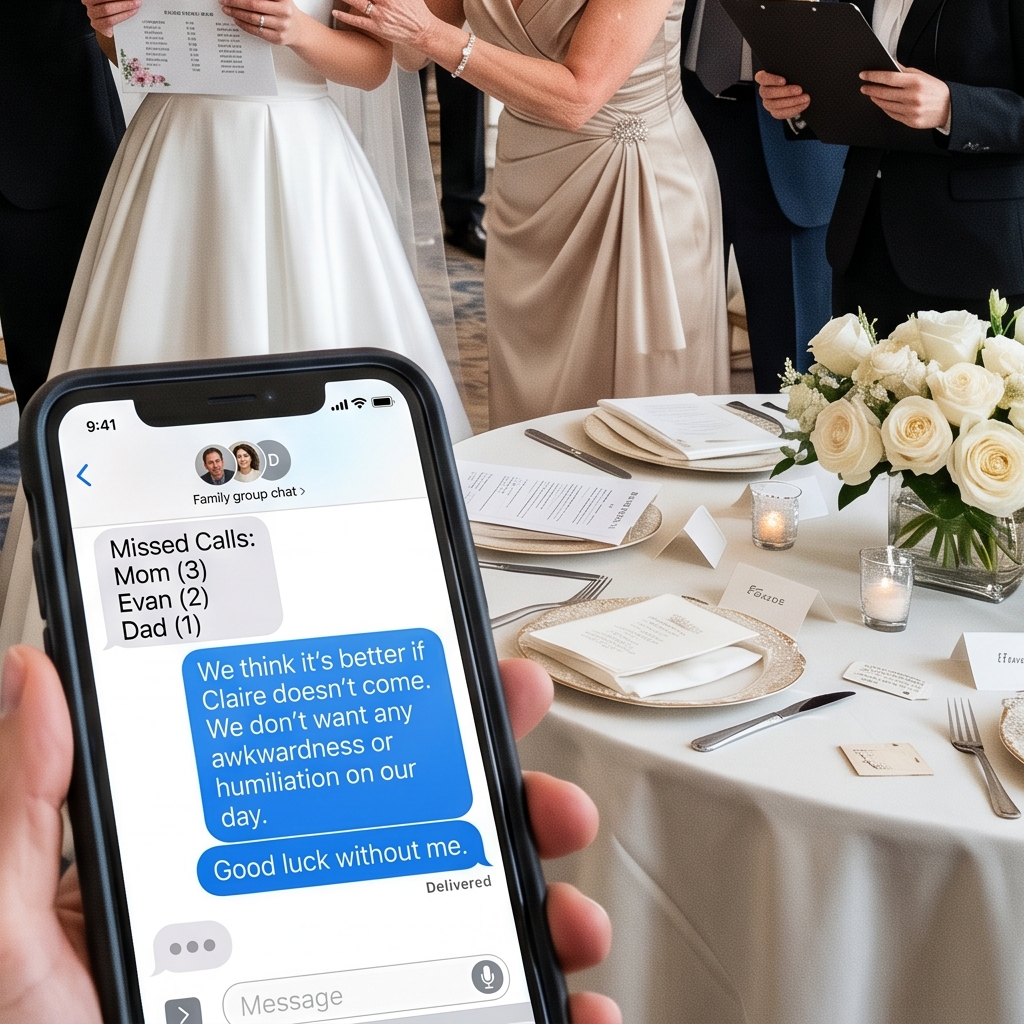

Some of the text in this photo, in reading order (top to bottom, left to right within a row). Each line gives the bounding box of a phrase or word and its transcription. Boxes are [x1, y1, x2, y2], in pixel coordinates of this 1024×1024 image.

[86, 418, 116, 433] 9:41
[267, 453, 280, 467] D
[193, 486, 298, 505] Family group chat
[109, 528, 255, 559] Missed Calls:
[113, 558, 207, 586] Mom (3)
[117, 586, 209, 613] Evan (2)
[121, 613, 201, 641] Dad (1)
[196, 660, 234, 682] We
[239, 653, 296, 678] think
[338, 646, 406, 669] better
[411, 640, 425, 661] if
[202, 686, 267, 711] Claire
[362, 674, 431, 695] come.
[205, 717, 244, 739] We
[312, 706, 369, 729] want
[374, 704, 413, 725] any
[212, 735, 393, 769] awkwardness or
[215, 762, 417, 798] humiliation on our
[221, 806, 267, 830] day.
[214, 839, 467, 881] Good luck without me.
[425, 874, 492, 894] Delivered
[241, 990, 343, 1017] Message
